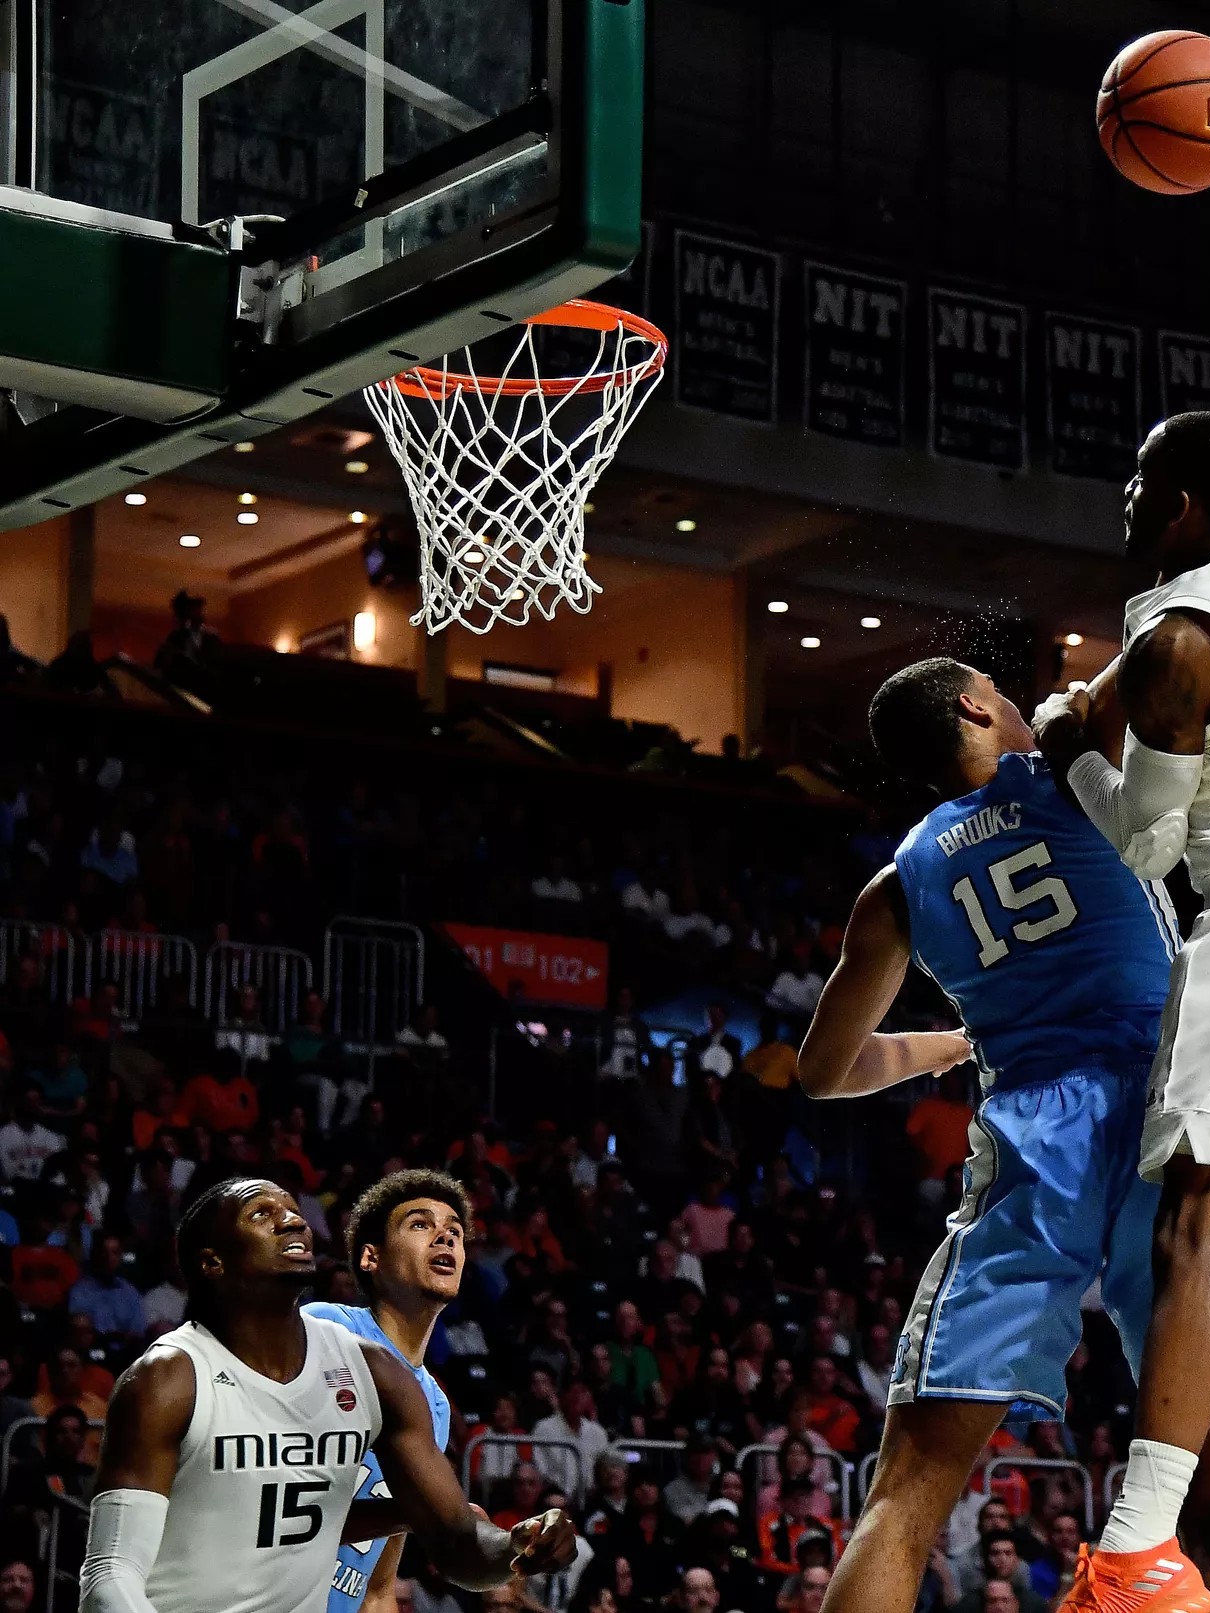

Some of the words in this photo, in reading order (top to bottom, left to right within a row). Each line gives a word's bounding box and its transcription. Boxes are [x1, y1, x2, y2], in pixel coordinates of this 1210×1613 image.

[684, 250, 769, 310] NCAA
[813, 279, 899, 339] NIT
[937, 304, 1017, 360] NIT
[1053, 325, 1130, 380] NIT
[936, 802, 1022, 858] BROOKS
[951, 840, 1079, 970] 15
[539, 954, 584, 985] 102
[255, 1480, 331, 1549] 15
